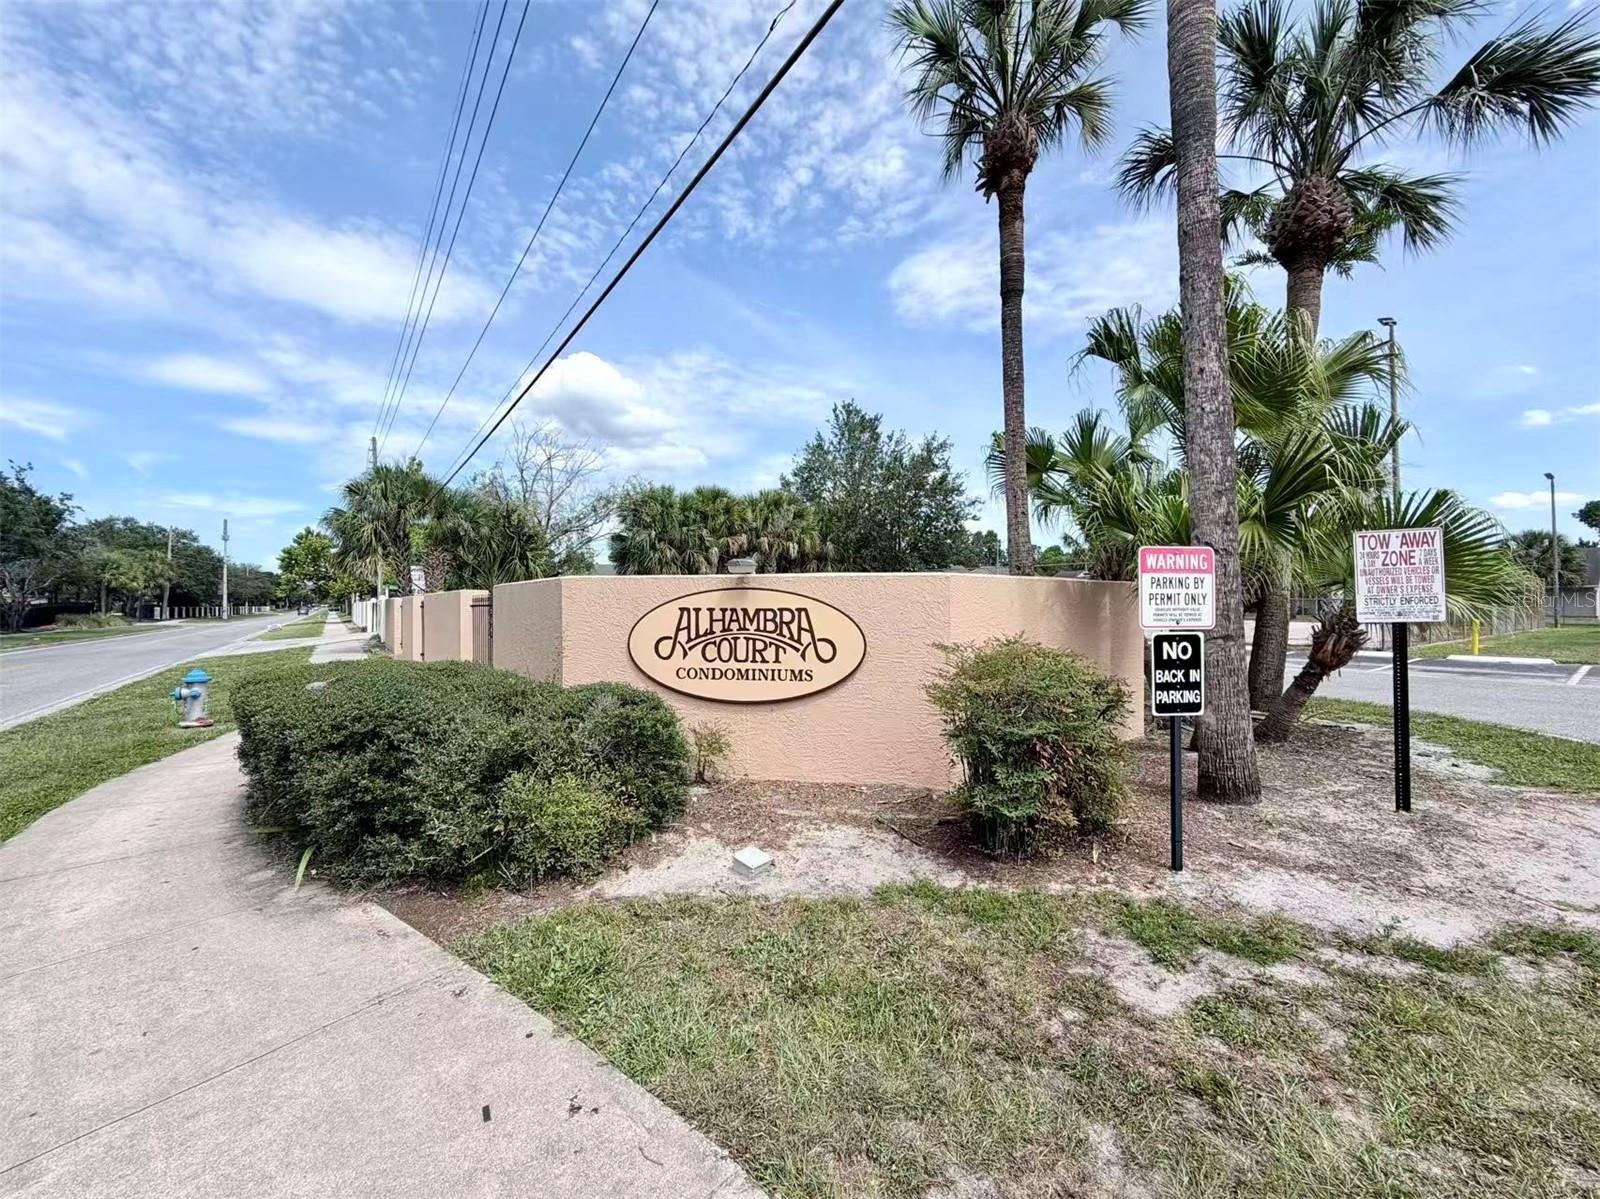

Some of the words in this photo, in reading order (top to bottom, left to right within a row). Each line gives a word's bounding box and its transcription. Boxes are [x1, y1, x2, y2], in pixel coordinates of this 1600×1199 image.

[1359, 534, 1391, 551] TOW
[1400, 531, 1437, 549] AWAY
[1146, 554, 1208, 570] WARNING
[1381, 550, 1416, 567] ZONE
[1360, 567, 1402, 577] UNAUTHORIZED
[1404, 566, 1430, 575] VEHICLES
[1432, 566, 1439, 575] OR
[1150, 577, 1190, 590] PARKING
[1193, 577, 1205, 589] BY
[1365, 577, 1390, 586] VESSELS
[1391, 577, 1404, 585] WILL
[1406, 576, 1413, 584] BE
[1415, 575, 1435, 584] TOWED
[1367, 586, 1374, 595] AT
[1407, 585, 1433, 593] EXPENSE
[1149, 593, 1182, 606] PERMIT
[1185, 593, 1207, 606] ONLY
[1365, 597, 1397, 606] STRICTLY
[1401, 596, 1439, 605] ENFORCED
[654, 607, 837, 664] ALHAMBRA
[701, 637, 787, 664] COURT
[1162, 642, 1193, 660] NO
[676, 667, 814, 682] CONDOMINIUMS
[1156, 670, 1185, 683] BACK
[1190, 669, 1200, 683] IN
[1156, 690, 1201, 704] PARKING
